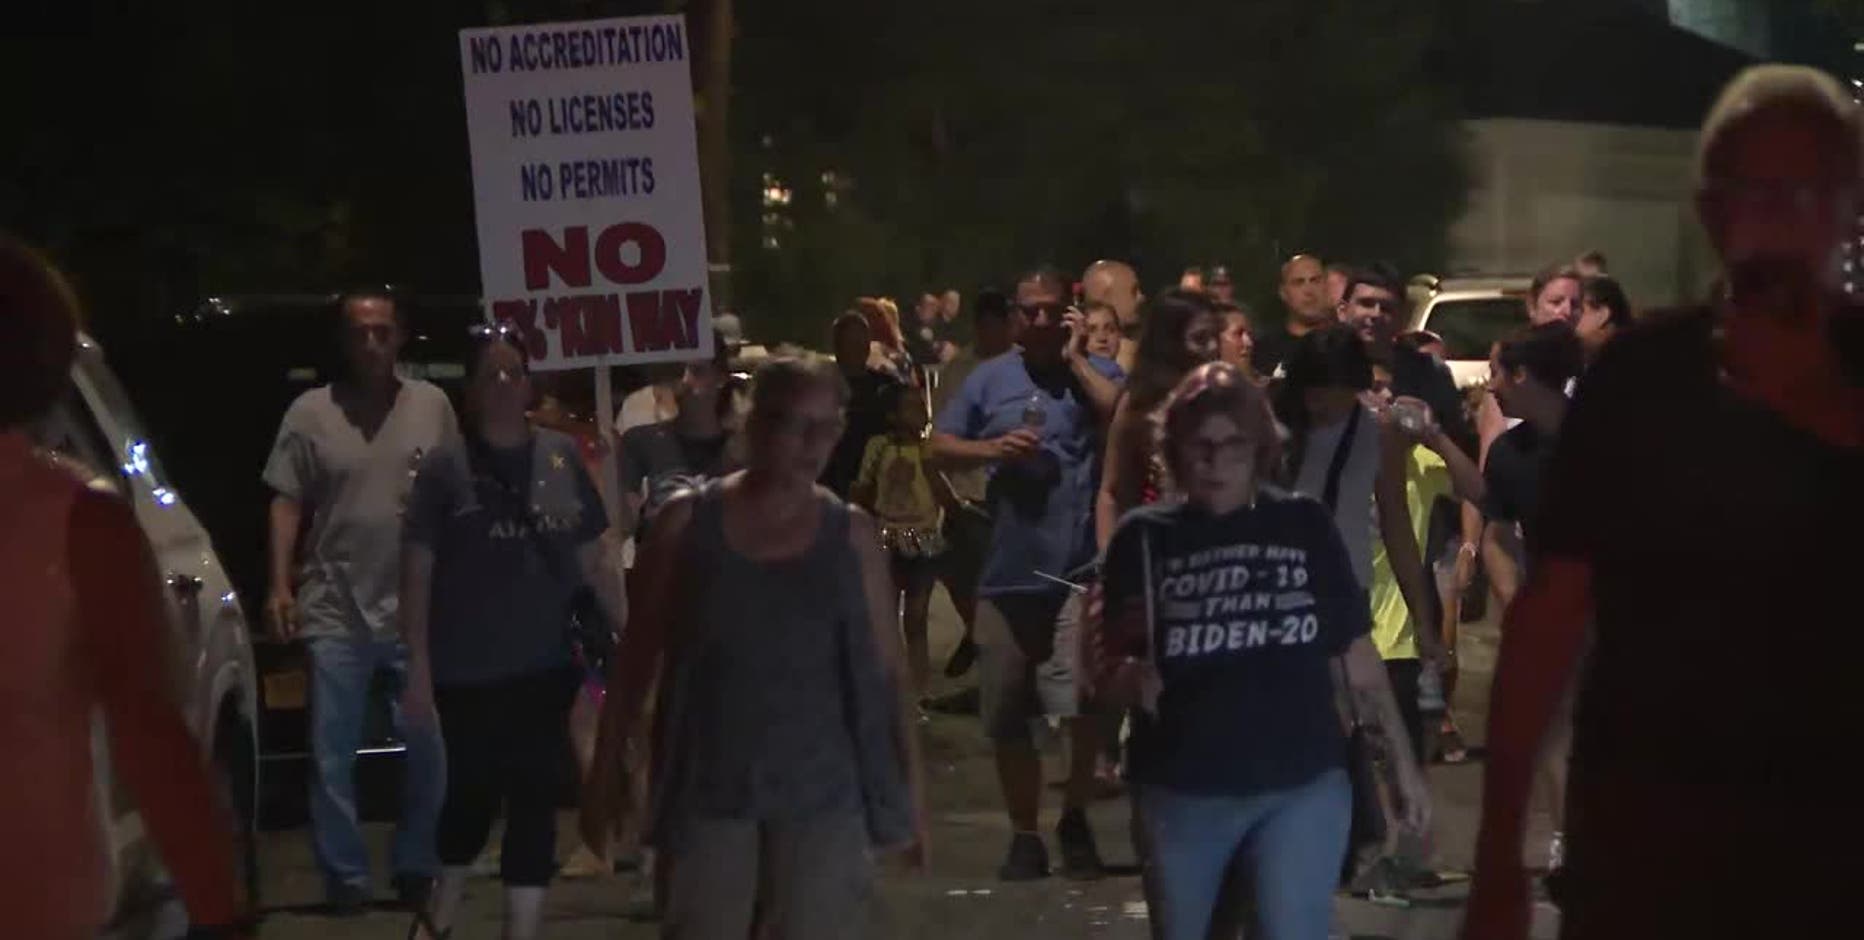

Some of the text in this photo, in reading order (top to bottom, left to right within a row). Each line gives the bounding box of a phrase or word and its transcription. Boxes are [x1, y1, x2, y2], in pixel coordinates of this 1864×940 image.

[470, 23, 683, 74] NO ACCREDITATION
[510, 91, 655, 137] NO LICENSES
[521, 157, 655, 201] NO PERMITS
[522, 222, 667, 291] NO
[626, 286, 703, 353] WAY
[1205, 592, 1272, 618] THAN
[1165, 612, 1318, 657] BIDEN-20
